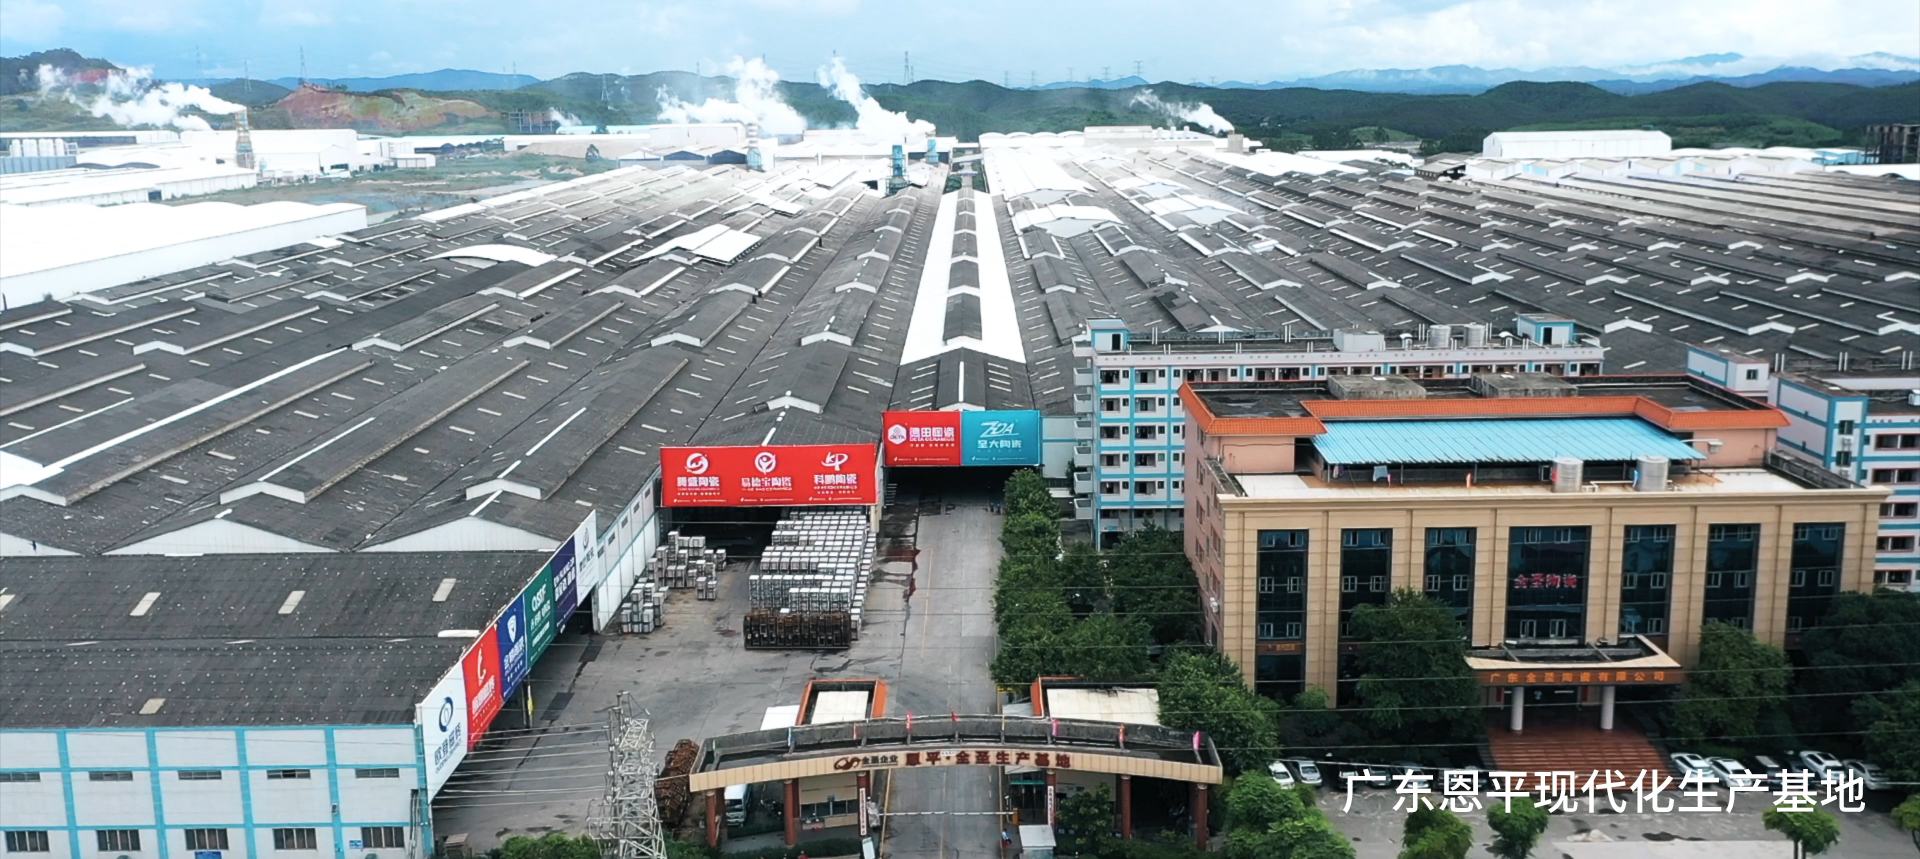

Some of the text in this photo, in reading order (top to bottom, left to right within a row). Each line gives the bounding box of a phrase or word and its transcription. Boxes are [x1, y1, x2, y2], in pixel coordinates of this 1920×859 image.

[1489, 671, 1666, 684] 广东金圣陶瓷有限公司
